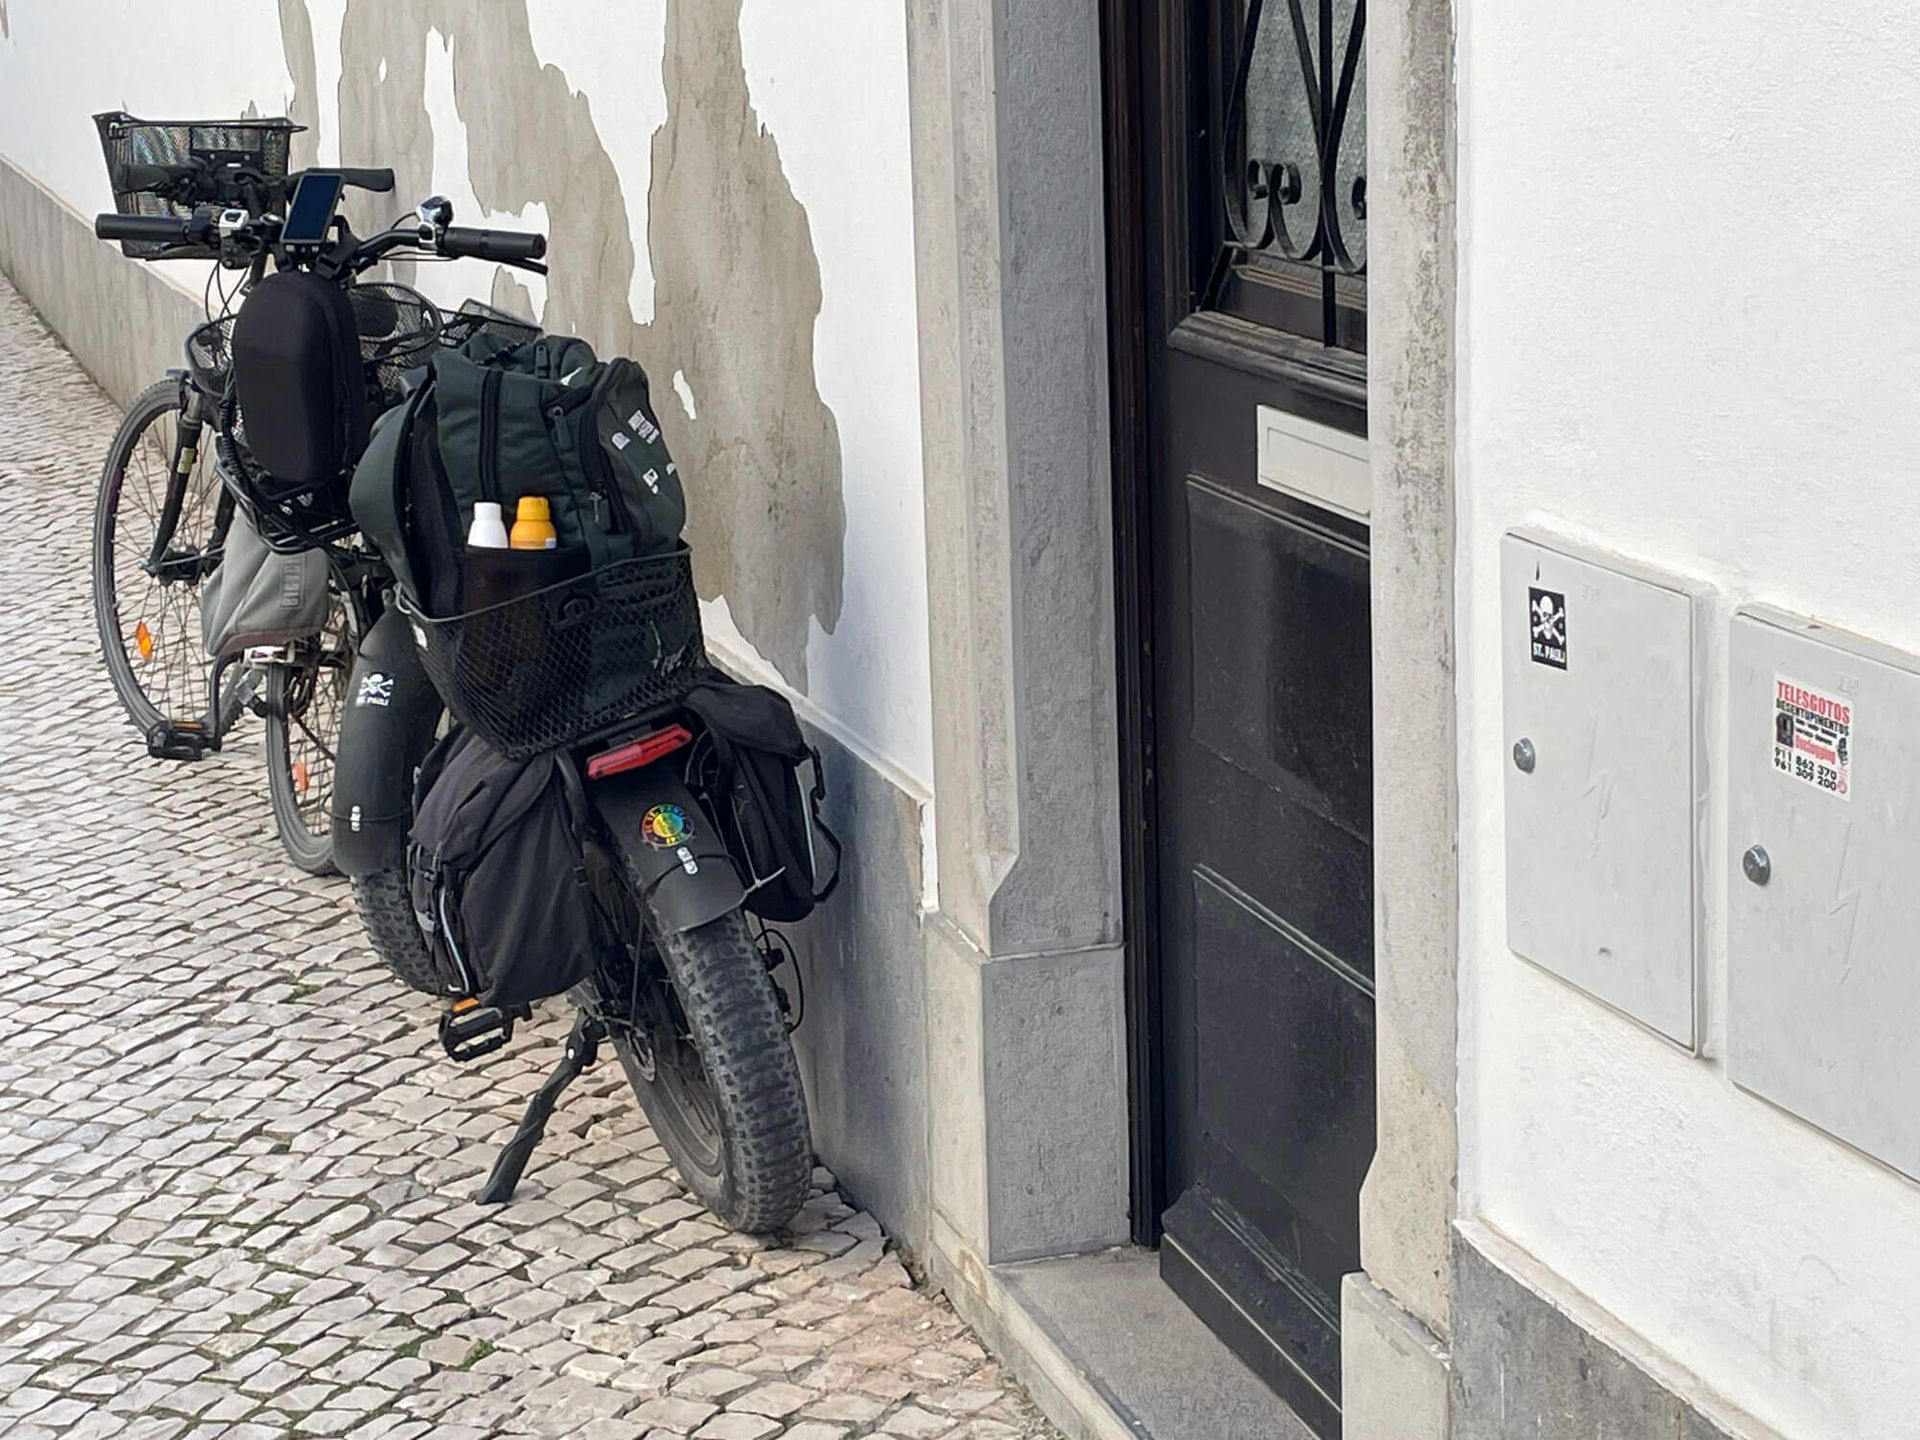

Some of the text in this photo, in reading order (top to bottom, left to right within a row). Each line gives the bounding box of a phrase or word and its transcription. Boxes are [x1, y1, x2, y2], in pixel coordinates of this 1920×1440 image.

[1545, 645, 1566, 663] PAULI
[1776, 680, 1850, 725] TELESGOTOS
[1774, 758, 1836, 791] 961 309 200
[1775, 747, 1792, 762] 911
[1796, 756, 1815, 771] 862
[1817, 765, 1837, 781] 370
